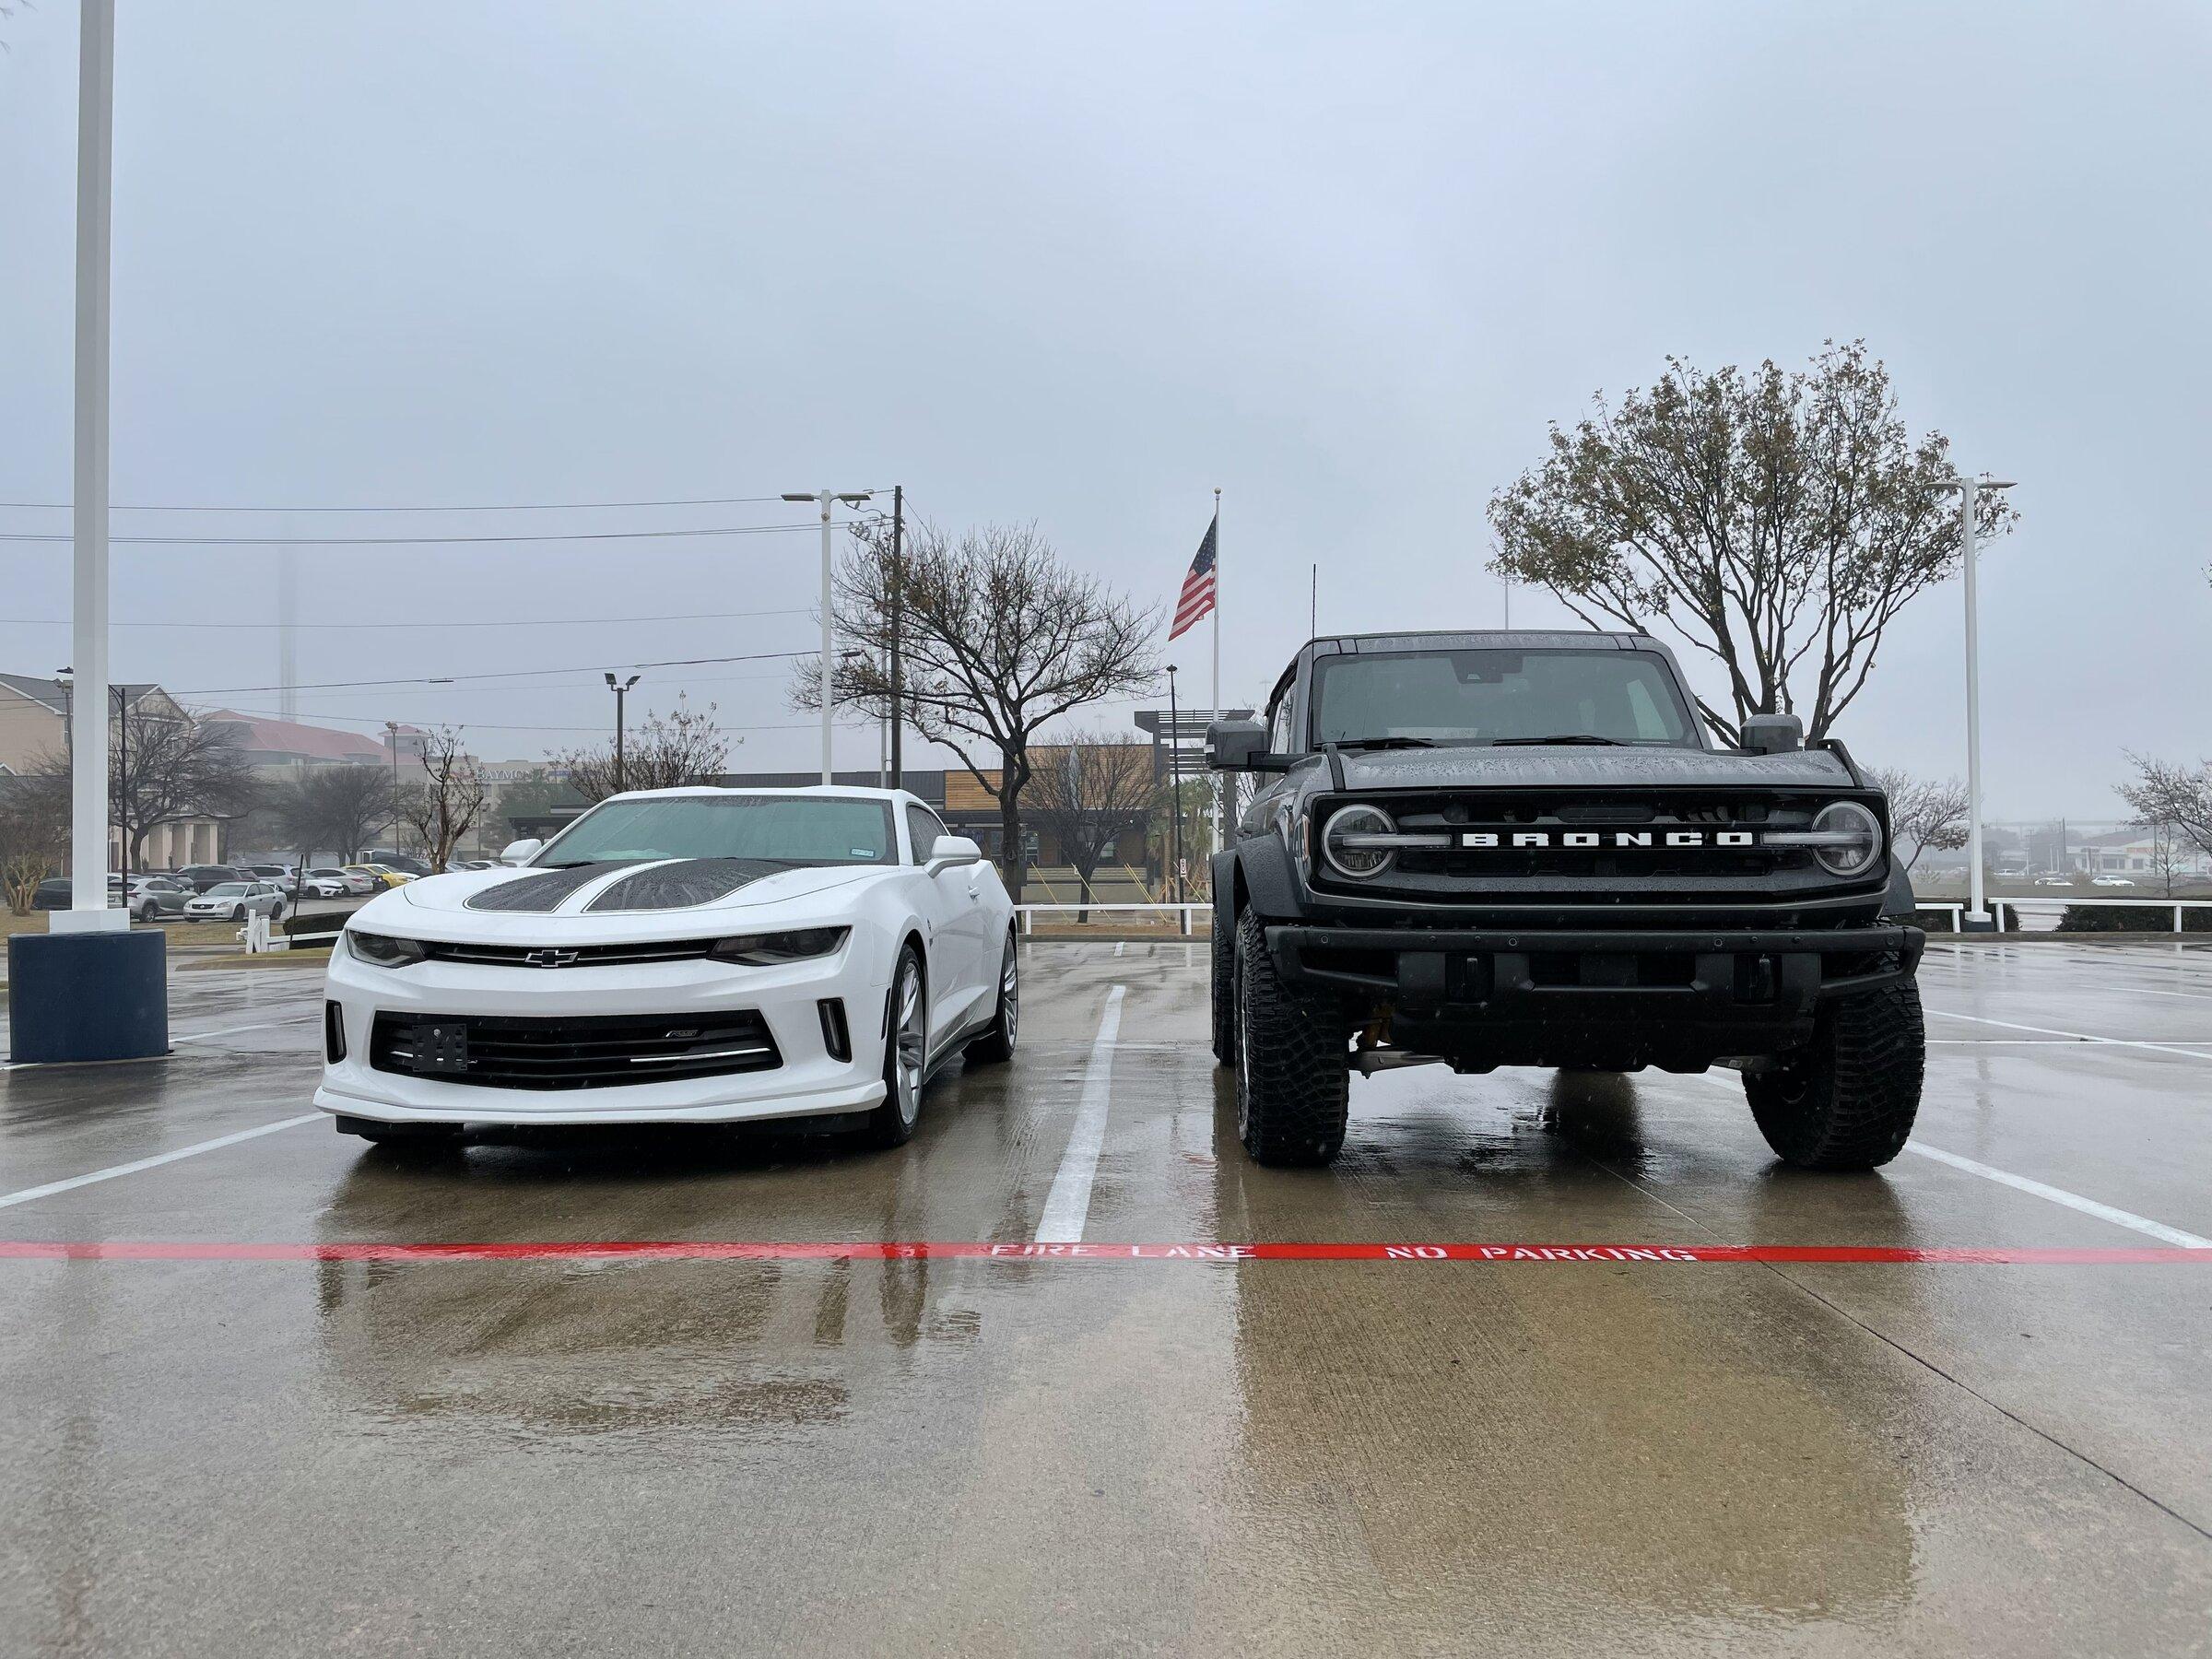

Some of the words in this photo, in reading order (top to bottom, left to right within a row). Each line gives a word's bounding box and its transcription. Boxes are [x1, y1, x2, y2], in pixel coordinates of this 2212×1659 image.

[476, 769, 534, 780] BAYMON
[1462, 832, 1752, 846] BRONCO
[991, 1245, 1099, 1256] FIRE
[1132, 1246, 1256, 1258] LANE
[1384, 1246, 1448, 1259] NO
[1480, 1247, 1698, 1261] PARKING
